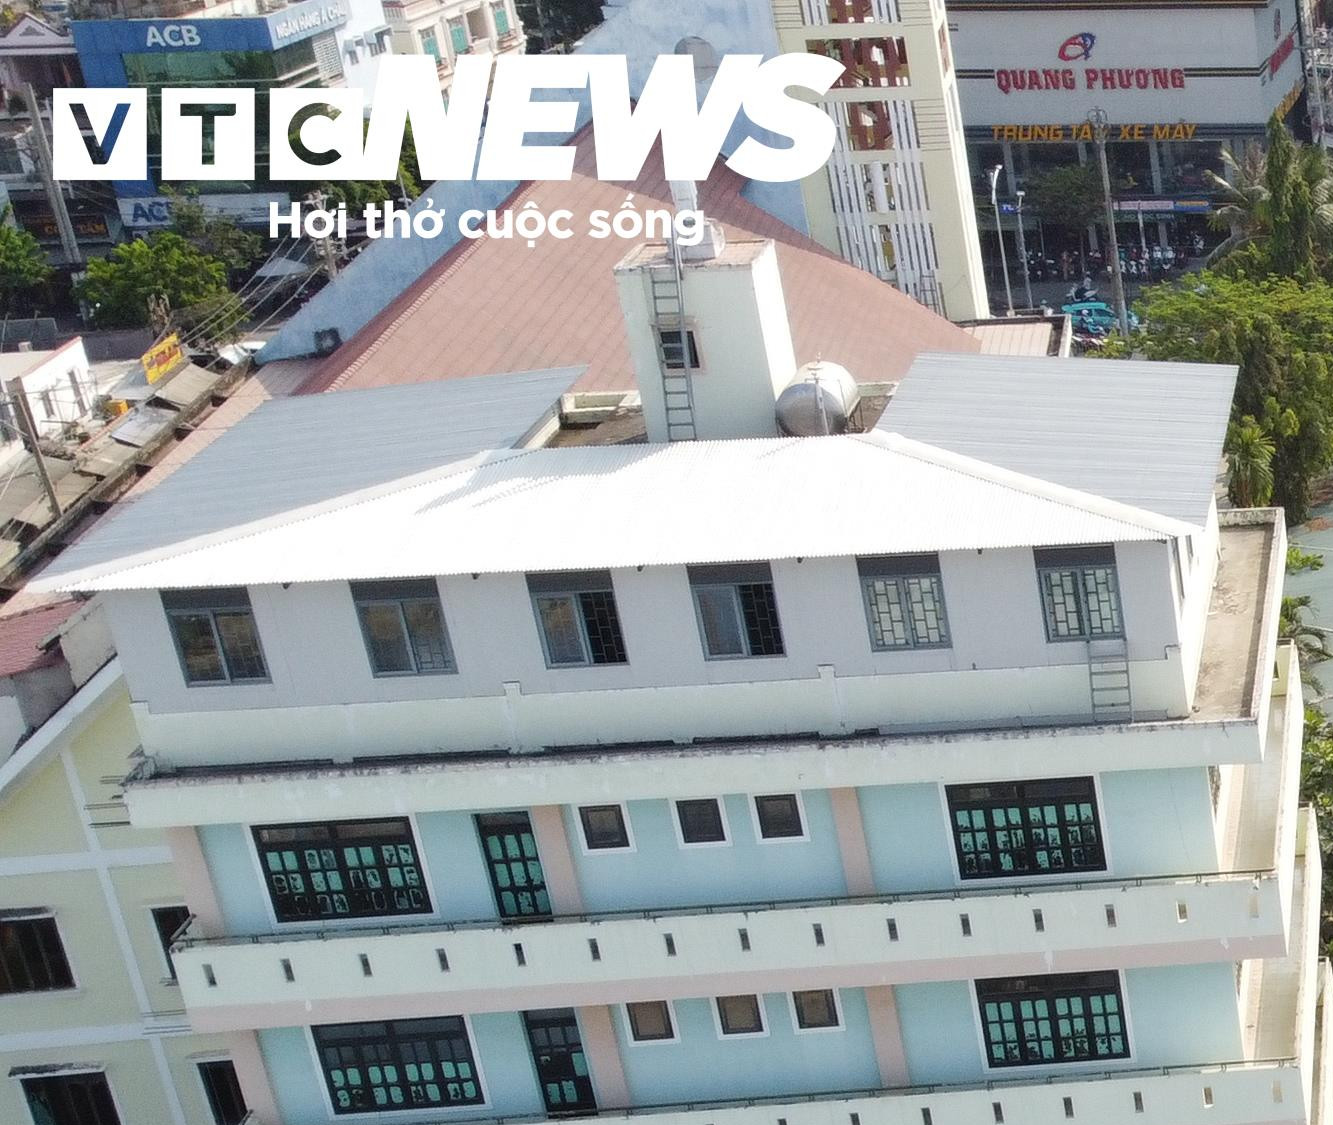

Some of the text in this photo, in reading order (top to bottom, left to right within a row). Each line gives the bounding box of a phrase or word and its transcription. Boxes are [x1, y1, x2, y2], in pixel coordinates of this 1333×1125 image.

[146, 25, 201, 47] ACB
[996, 68, 1185, 94] QUANG PHƯƠNG
[991, 125, 1063, 141] TRUNG
[1120, 124, 1146, 140] XE
[132, 201, 173, 223] AC
